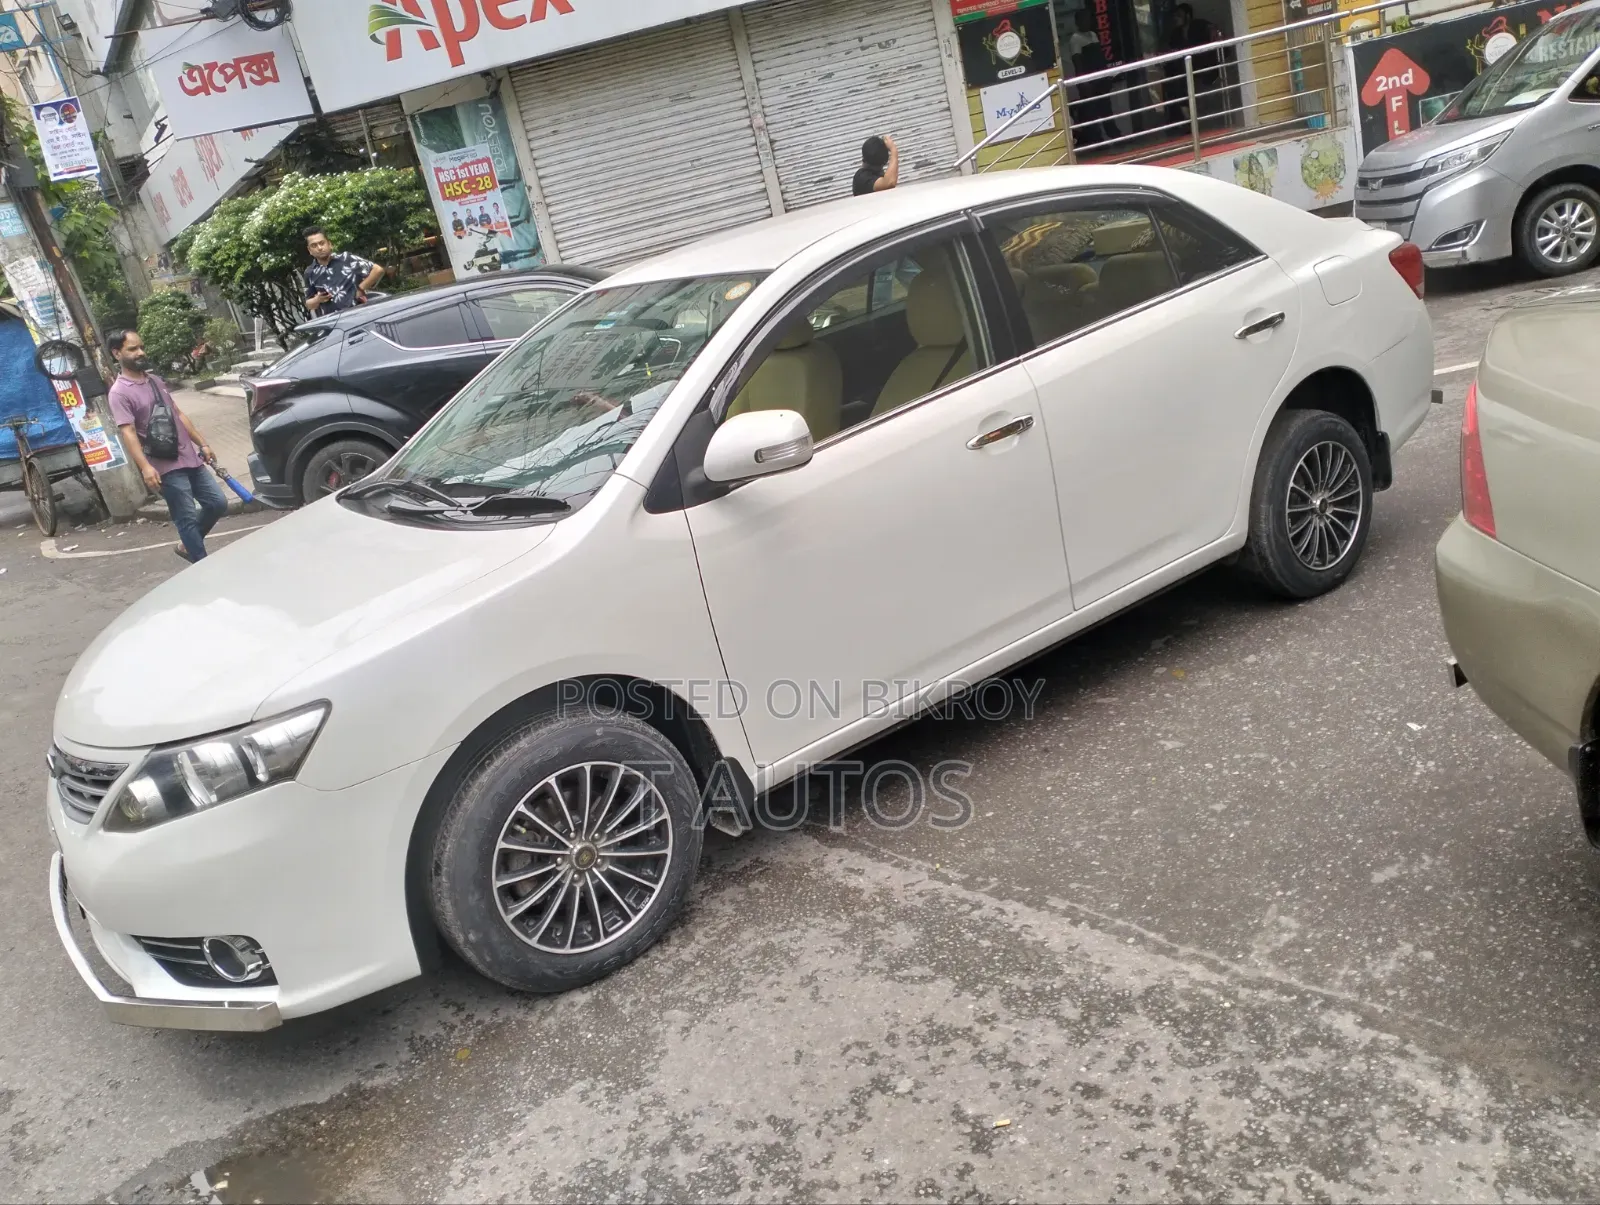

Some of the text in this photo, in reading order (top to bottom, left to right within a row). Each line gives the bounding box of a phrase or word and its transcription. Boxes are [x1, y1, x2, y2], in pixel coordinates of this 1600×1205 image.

[1539, 33, 1600, 61] RESTAU
[177, 51, 280, 96] এপেক্স
[1376, 68, 1413, 92] 2nd
[478, 103, 499, 139] YOU
[438, 162, 490, 183] HSC 1st YEAR
